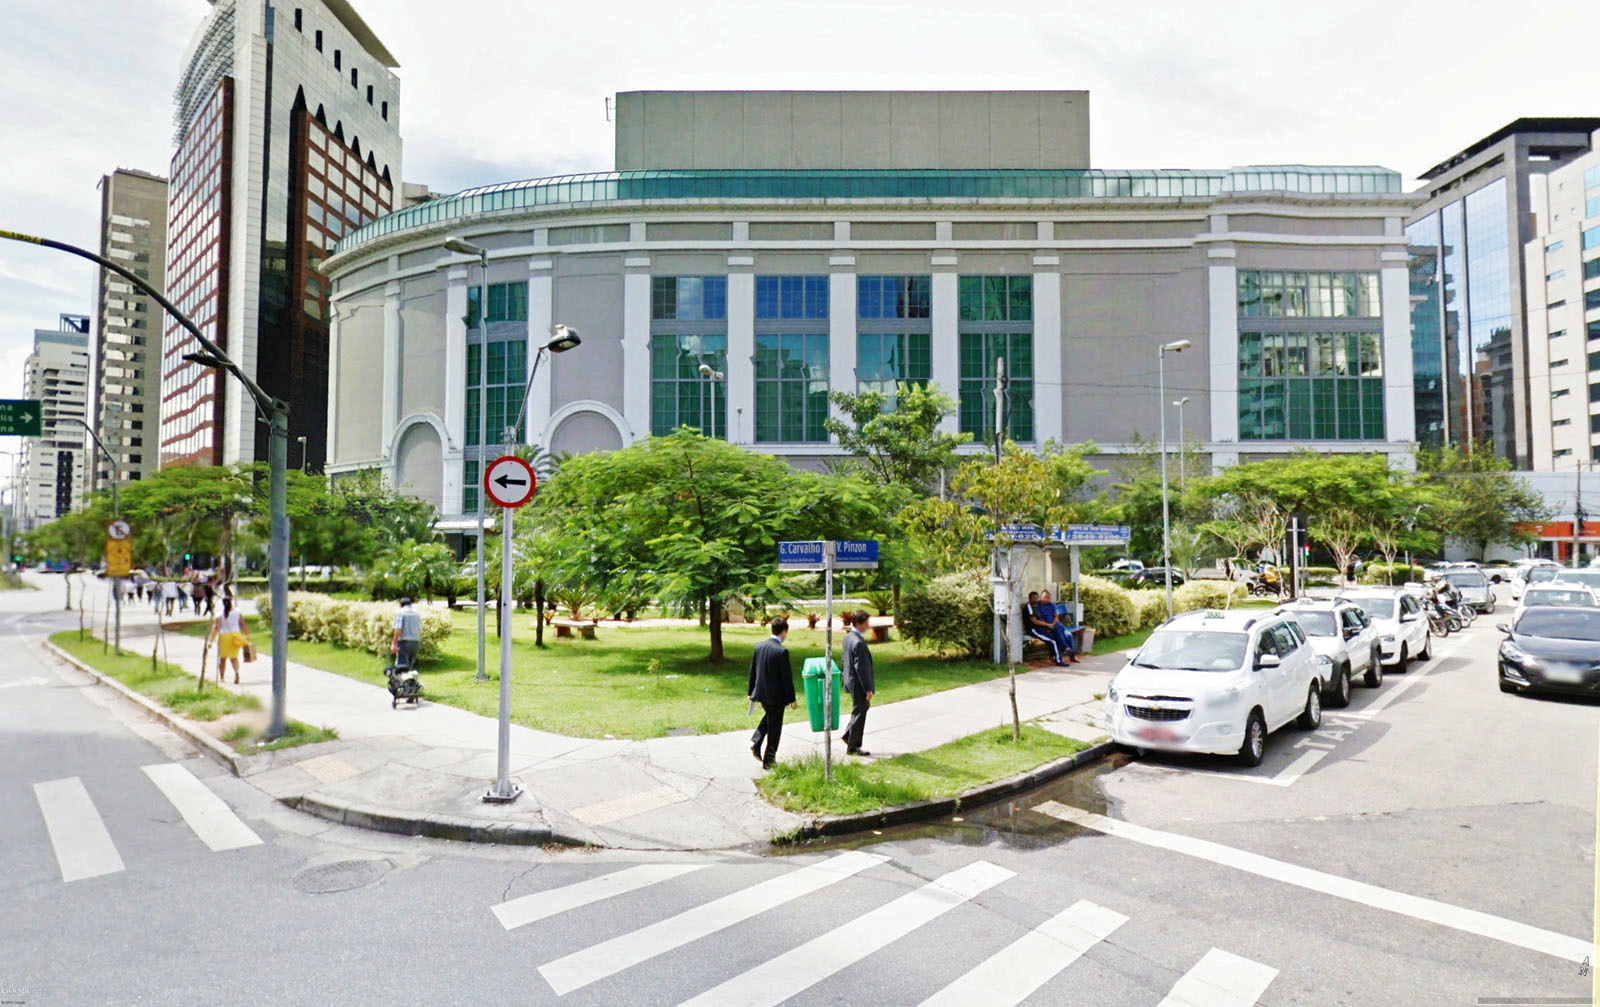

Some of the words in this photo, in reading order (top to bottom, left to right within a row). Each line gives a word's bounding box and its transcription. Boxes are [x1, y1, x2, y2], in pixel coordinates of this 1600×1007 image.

[780, 544, 787, 554] G.
[788, 542, 820, 554] Carvalho
[843, 540, 867, 553] Pinzon
